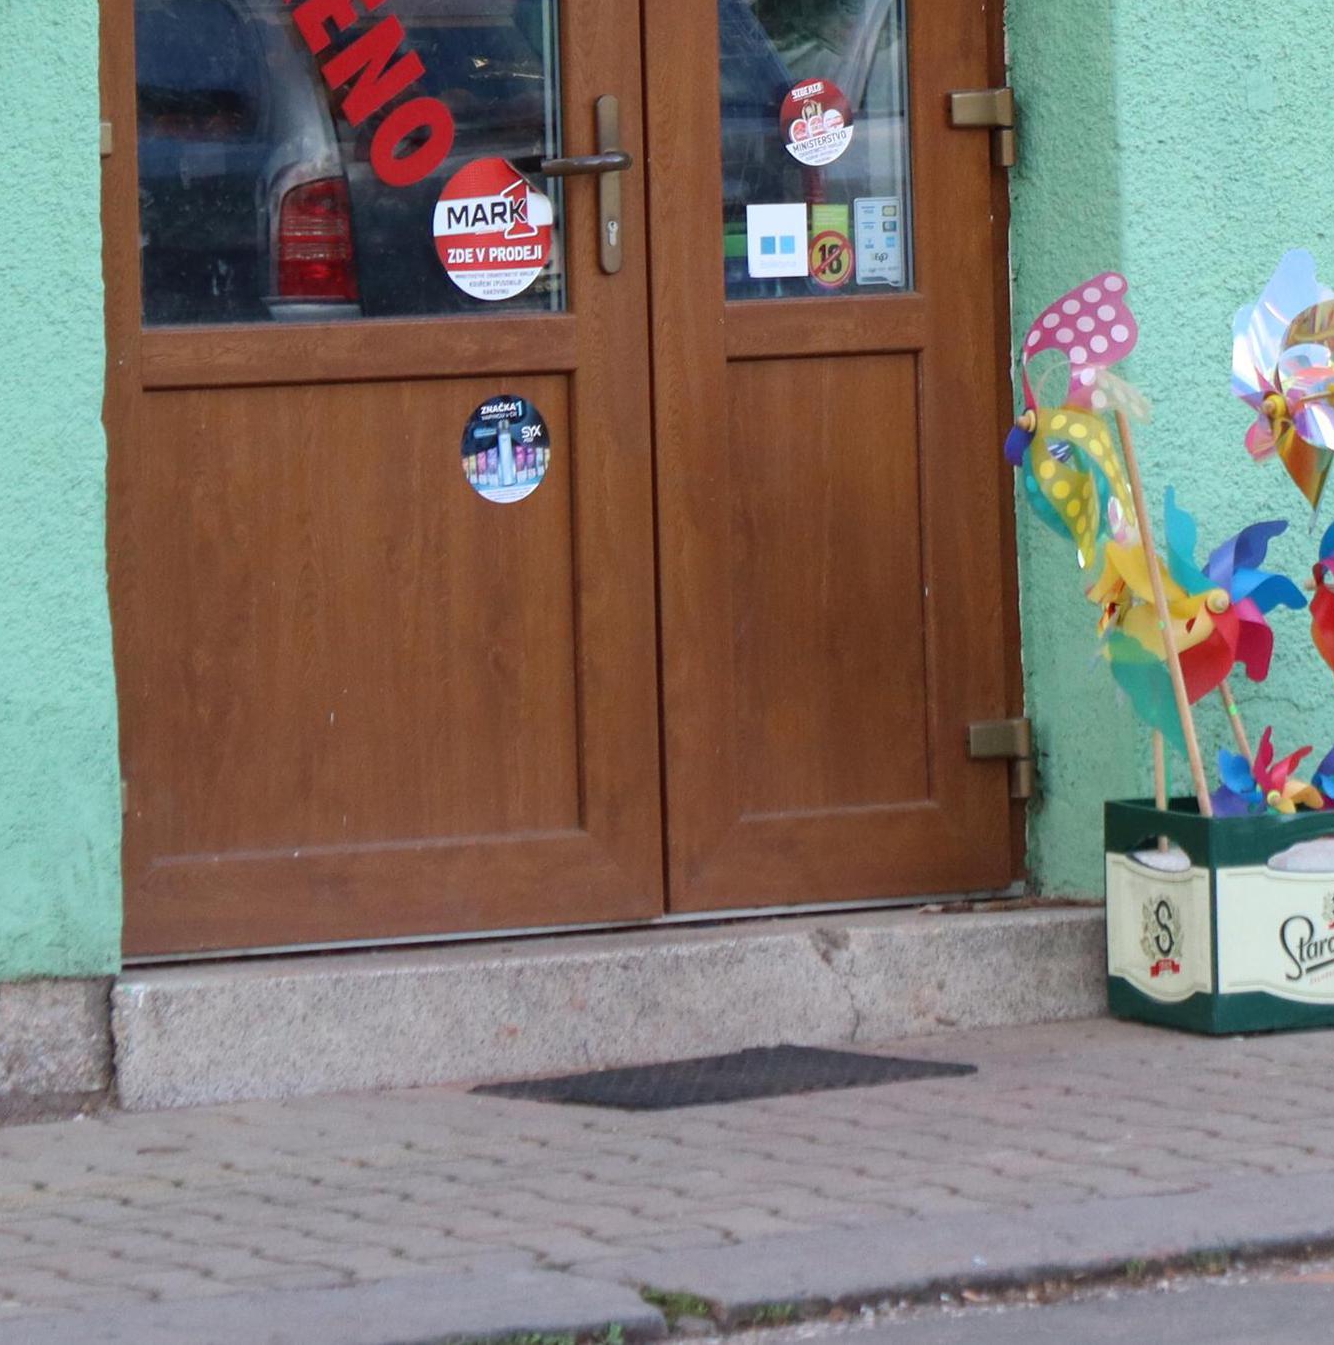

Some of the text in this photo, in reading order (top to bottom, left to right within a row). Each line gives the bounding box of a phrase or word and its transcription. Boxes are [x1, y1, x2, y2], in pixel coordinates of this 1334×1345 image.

[447, 198, 526, 229] MARK
[447, 245, 542, 264] ZDE V PRODEJI
[818, 244, 842, 275] 18
[1154, 900, 1175, 957] S
